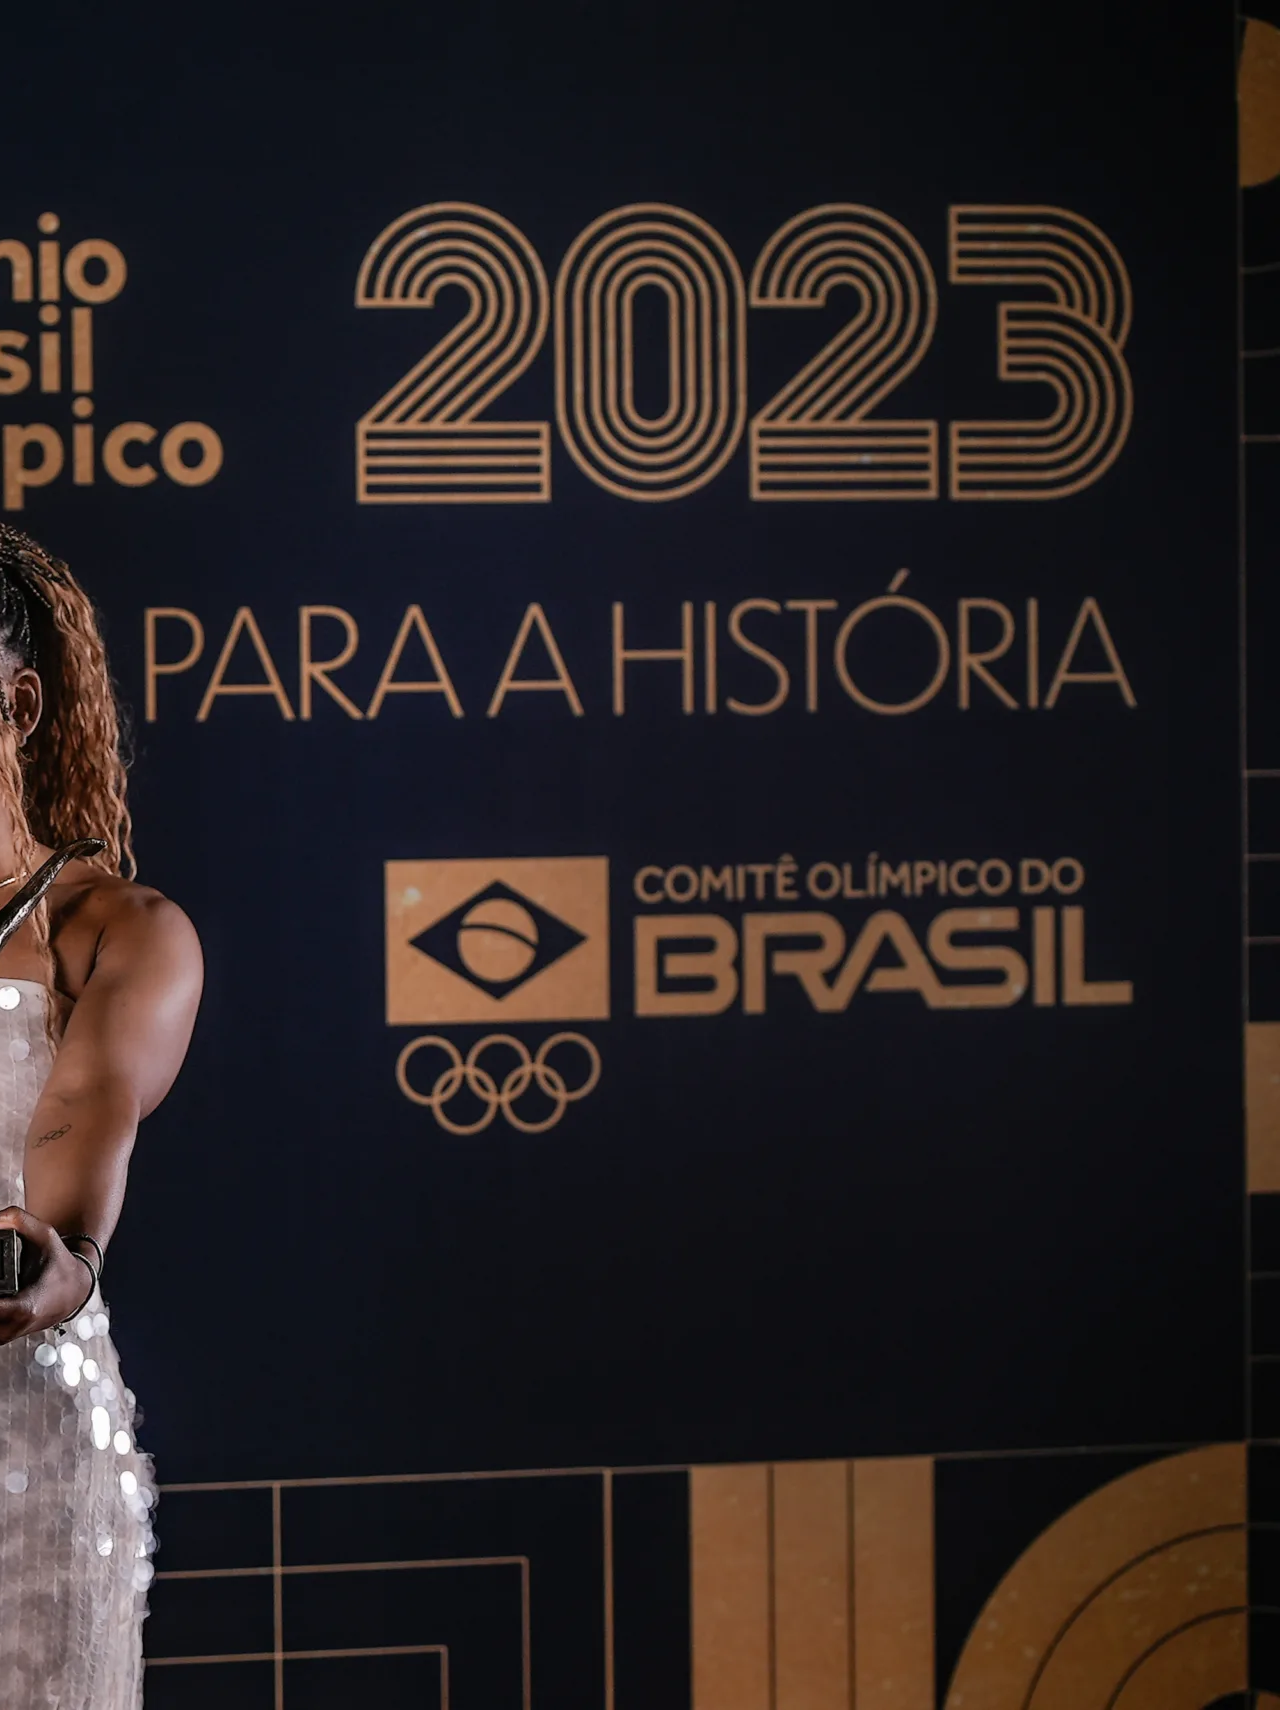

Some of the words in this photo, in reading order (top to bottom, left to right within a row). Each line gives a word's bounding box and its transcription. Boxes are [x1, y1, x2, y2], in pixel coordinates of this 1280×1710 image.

[356, 202, 1132, 504] 2023
[145, 605, 462, 722] PARA
[489, 604, 583, 716] A
[614, 569, 1136, 718] HISTÓRIA
[634, 854, 799, 902] COMITÊ
[806, 852, 1012, 899] OLÍMPICO
[1020, 857, 1084, 895] DO
[635, 906, 1133, 1017] BRASIL
